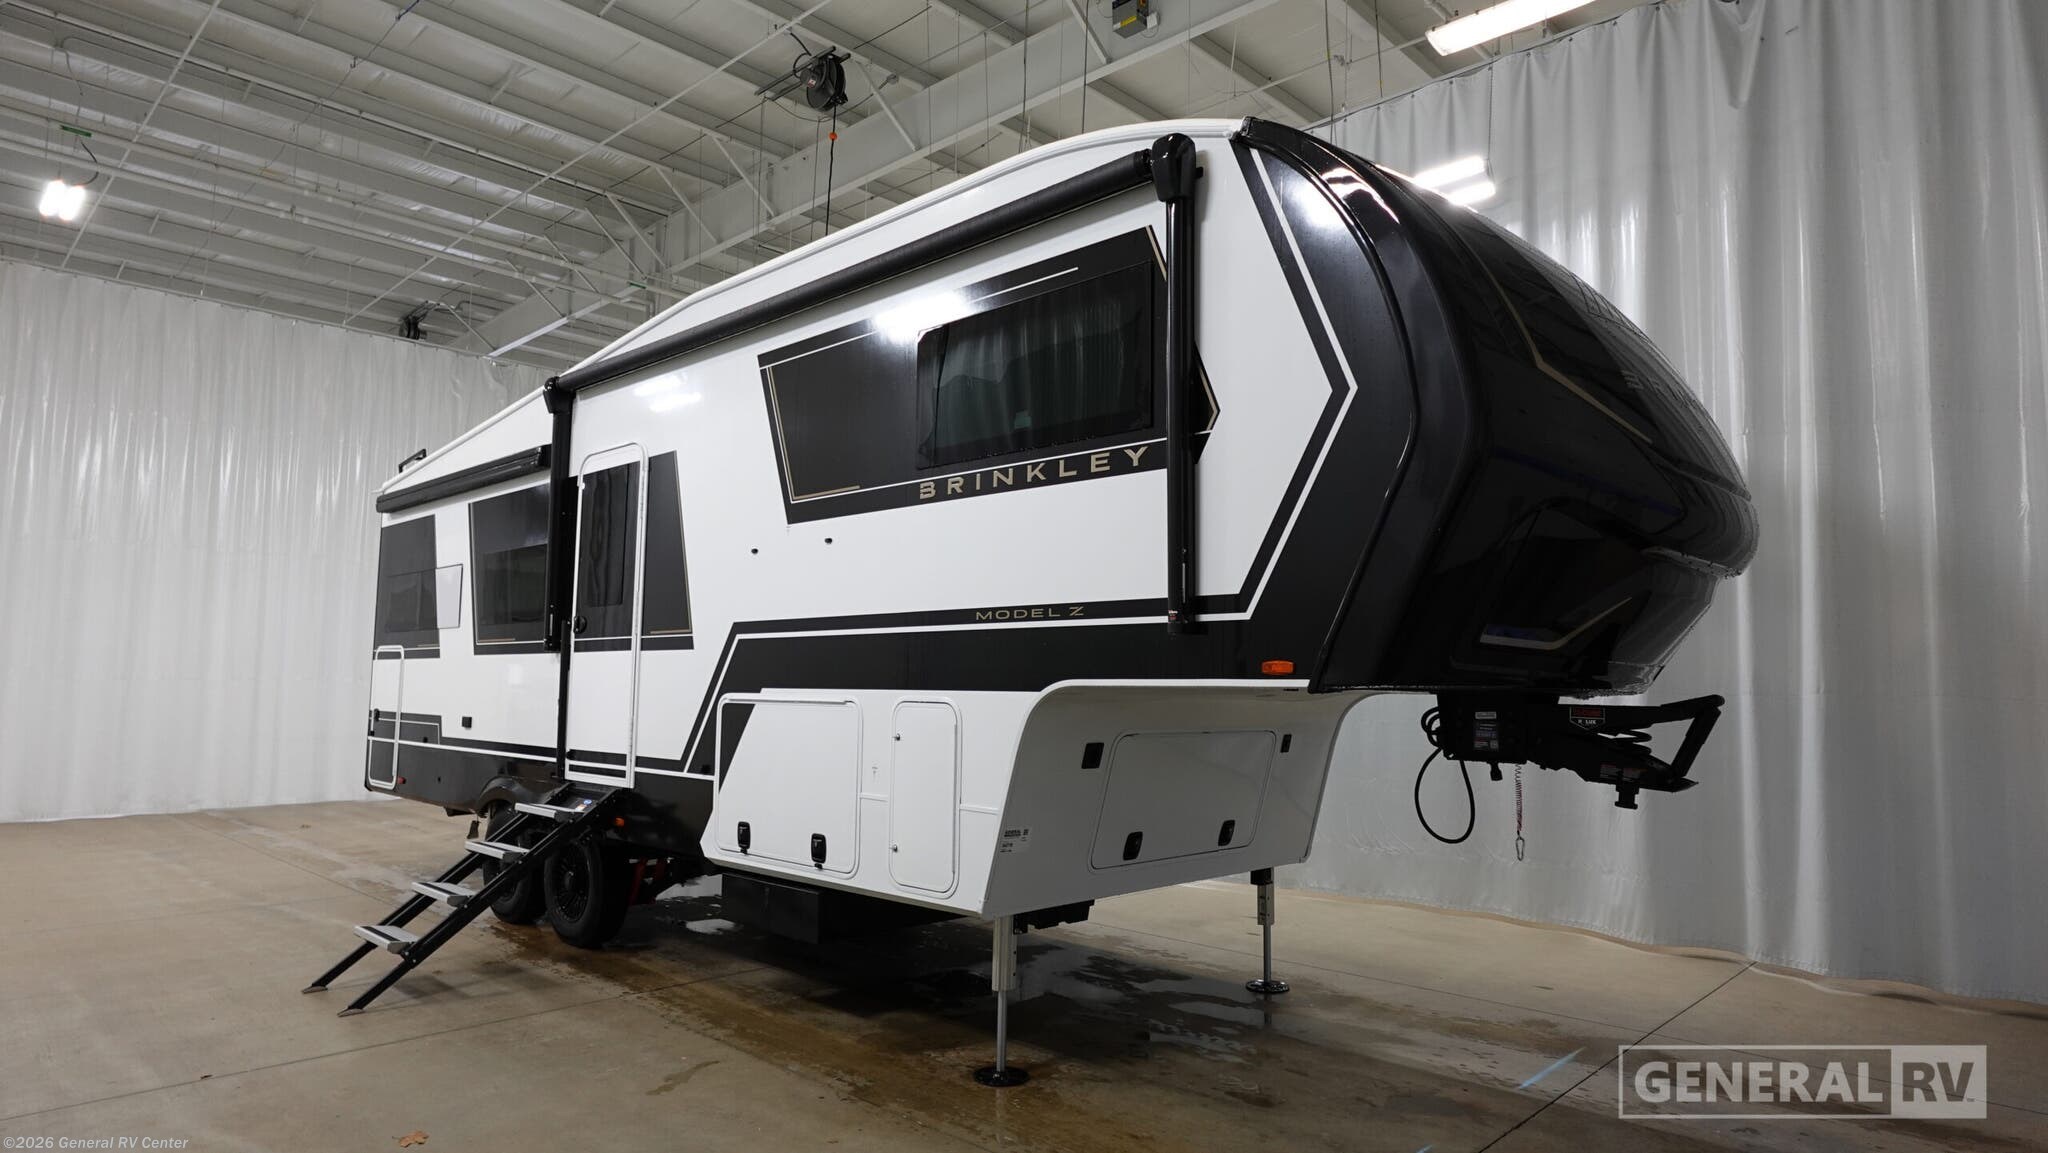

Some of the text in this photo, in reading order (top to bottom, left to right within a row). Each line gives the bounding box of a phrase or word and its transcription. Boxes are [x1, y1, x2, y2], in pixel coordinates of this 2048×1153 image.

[919, 446, 1149, 500] BRINKLEY
[976, 606, 1085, 621] MODEL Z
